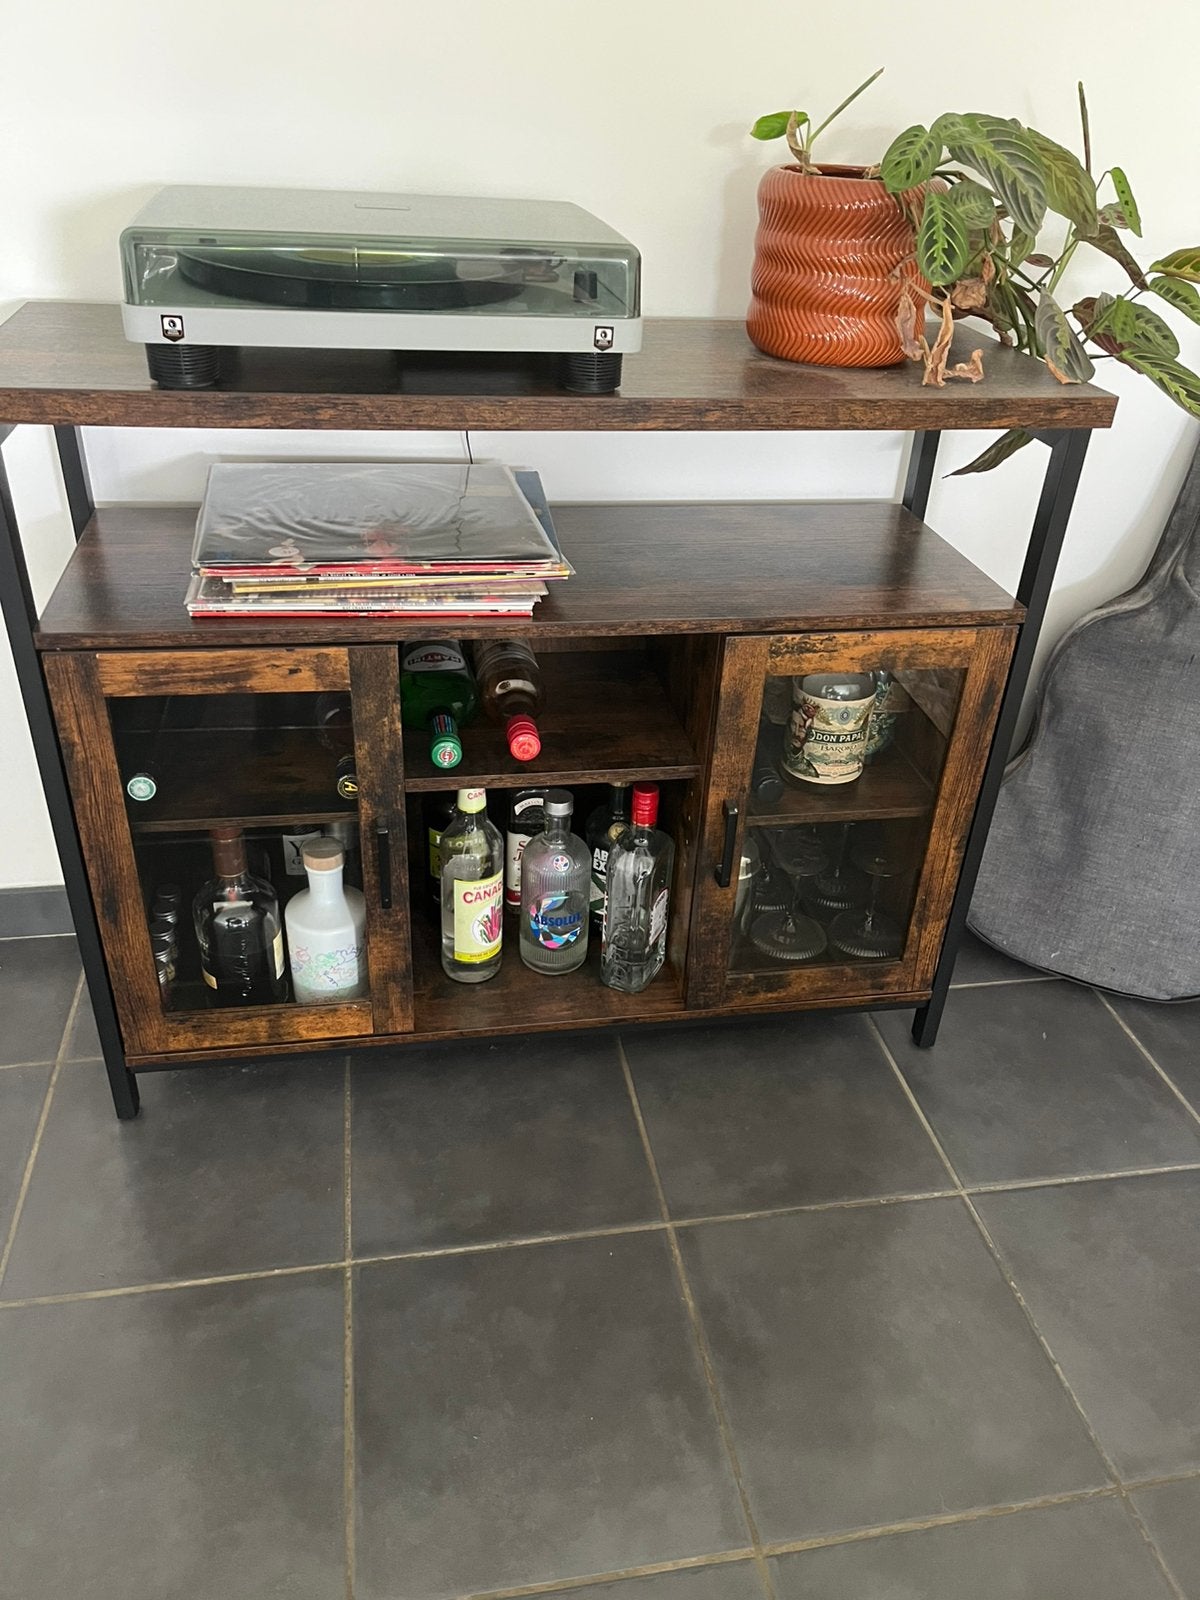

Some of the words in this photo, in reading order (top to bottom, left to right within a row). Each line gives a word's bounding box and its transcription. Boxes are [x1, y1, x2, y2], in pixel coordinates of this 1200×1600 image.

[816, 733, 837, 742] DON
[344, 781, 359, 792] A
[593, 847, 609, 862] AB
[592, 858, 607, 873] EX
